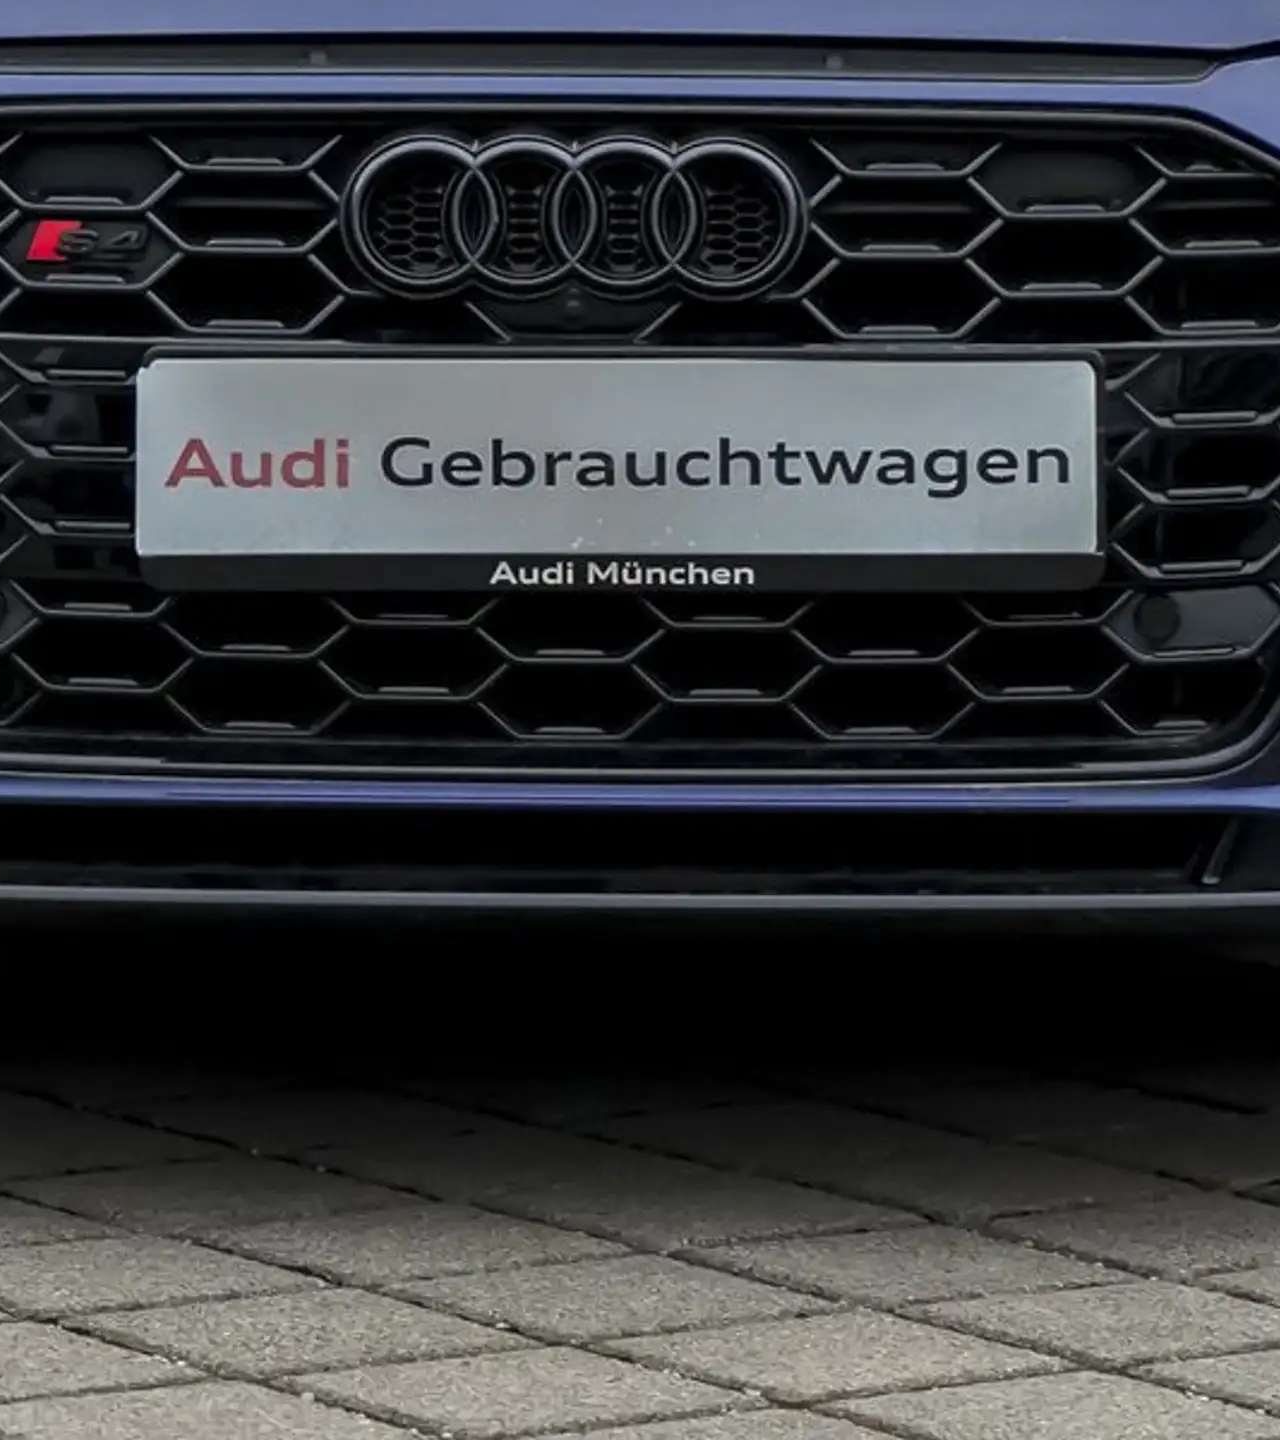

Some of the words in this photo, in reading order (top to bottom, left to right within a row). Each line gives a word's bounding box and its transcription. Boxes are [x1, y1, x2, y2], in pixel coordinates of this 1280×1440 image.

[163, 436, 351, 490] Audi
[380, 435, 1072, 500] Gebrauchtwagen
[488, 560, 575, 586] Audi
[586, 559, 756, 586] München
